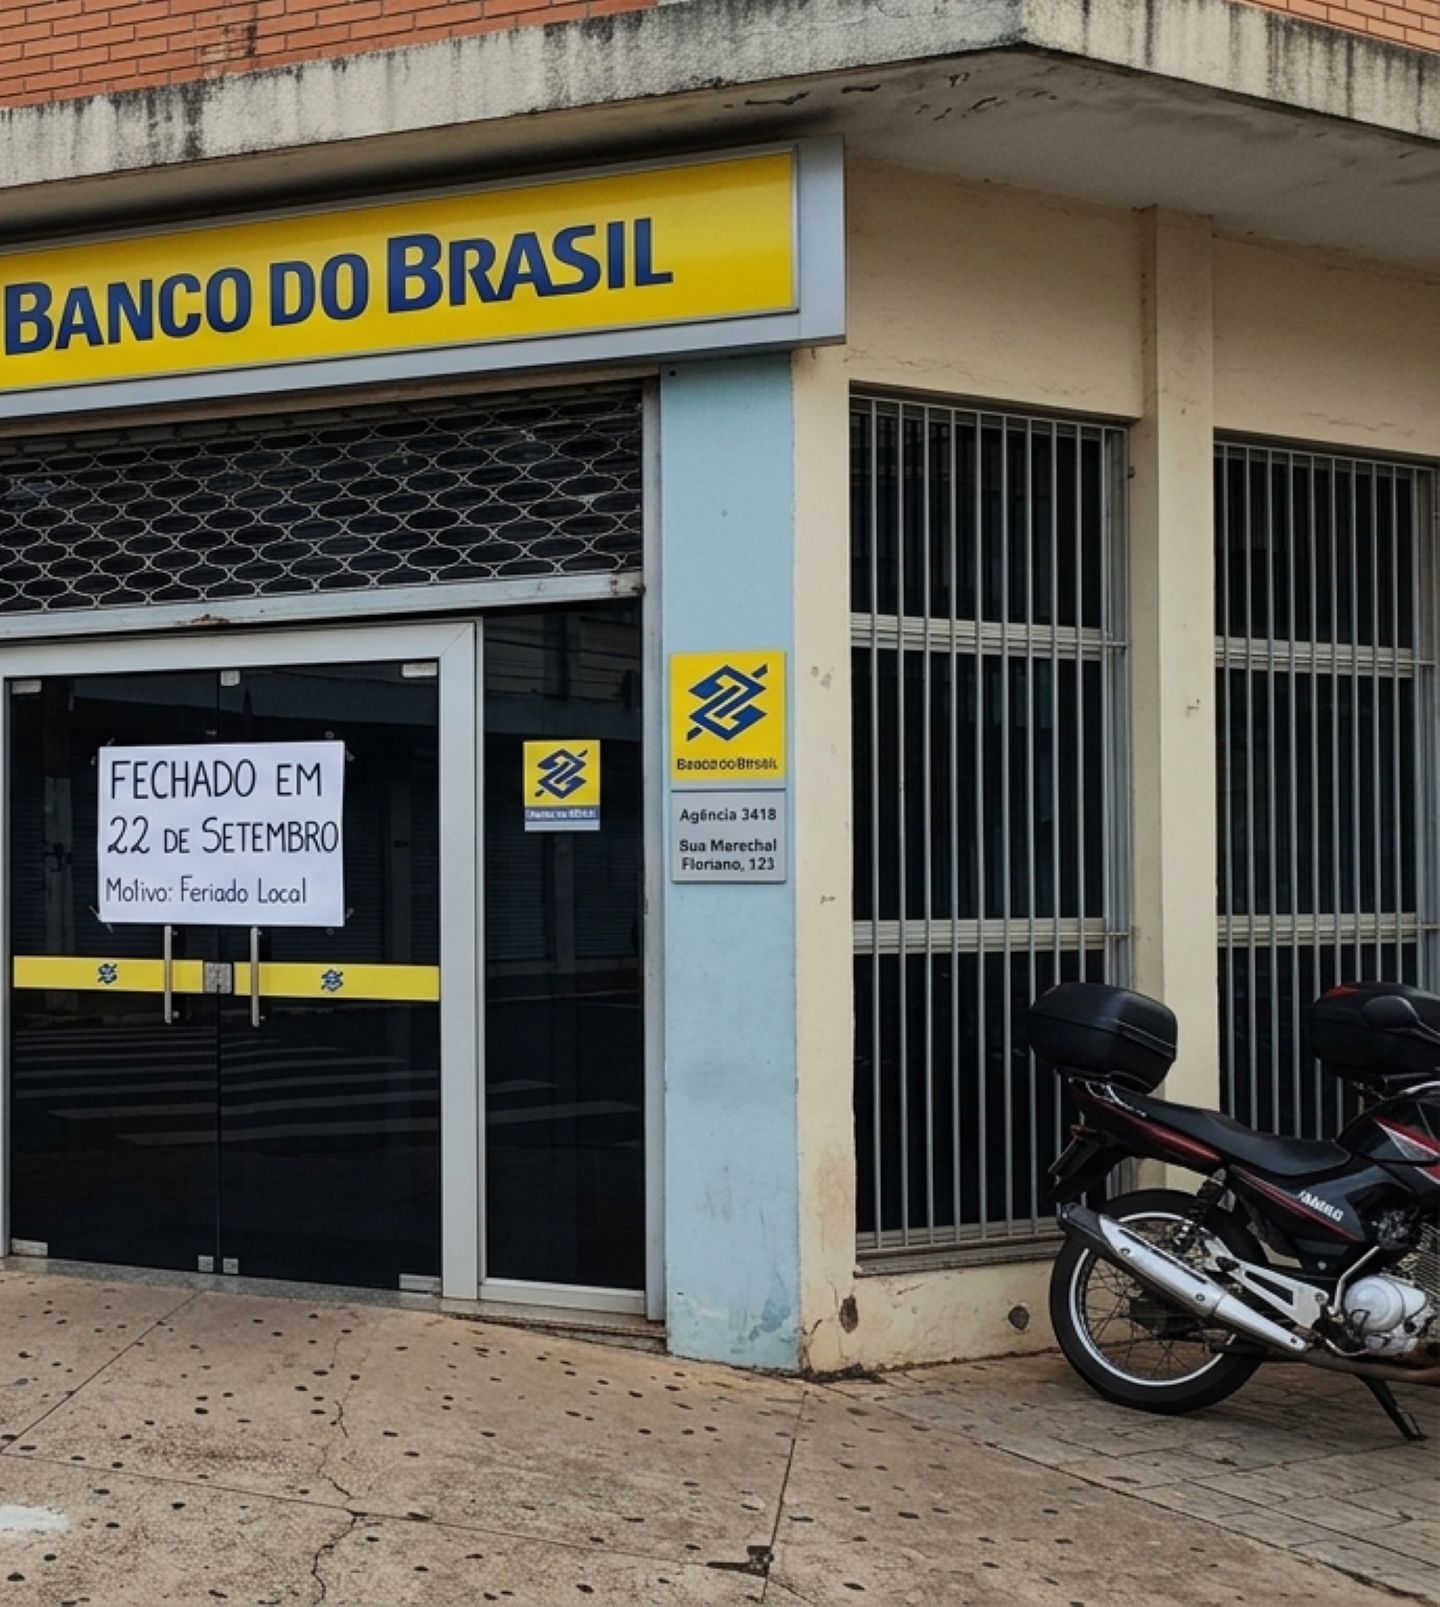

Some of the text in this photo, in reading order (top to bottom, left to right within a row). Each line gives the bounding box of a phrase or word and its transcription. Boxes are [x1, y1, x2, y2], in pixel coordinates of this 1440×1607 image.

[4, 216, 674, 355] BANCO DO BRASIL
[110, 758, 322, 799] FECHADO EM
[741, 807, 777, 821] 3418
[106, 815, 339, 855] 22 DE SETEMBRO
[748, 857, 775, 871] 123
[105, 874, 307, 905] Motivo: Feriado Local
